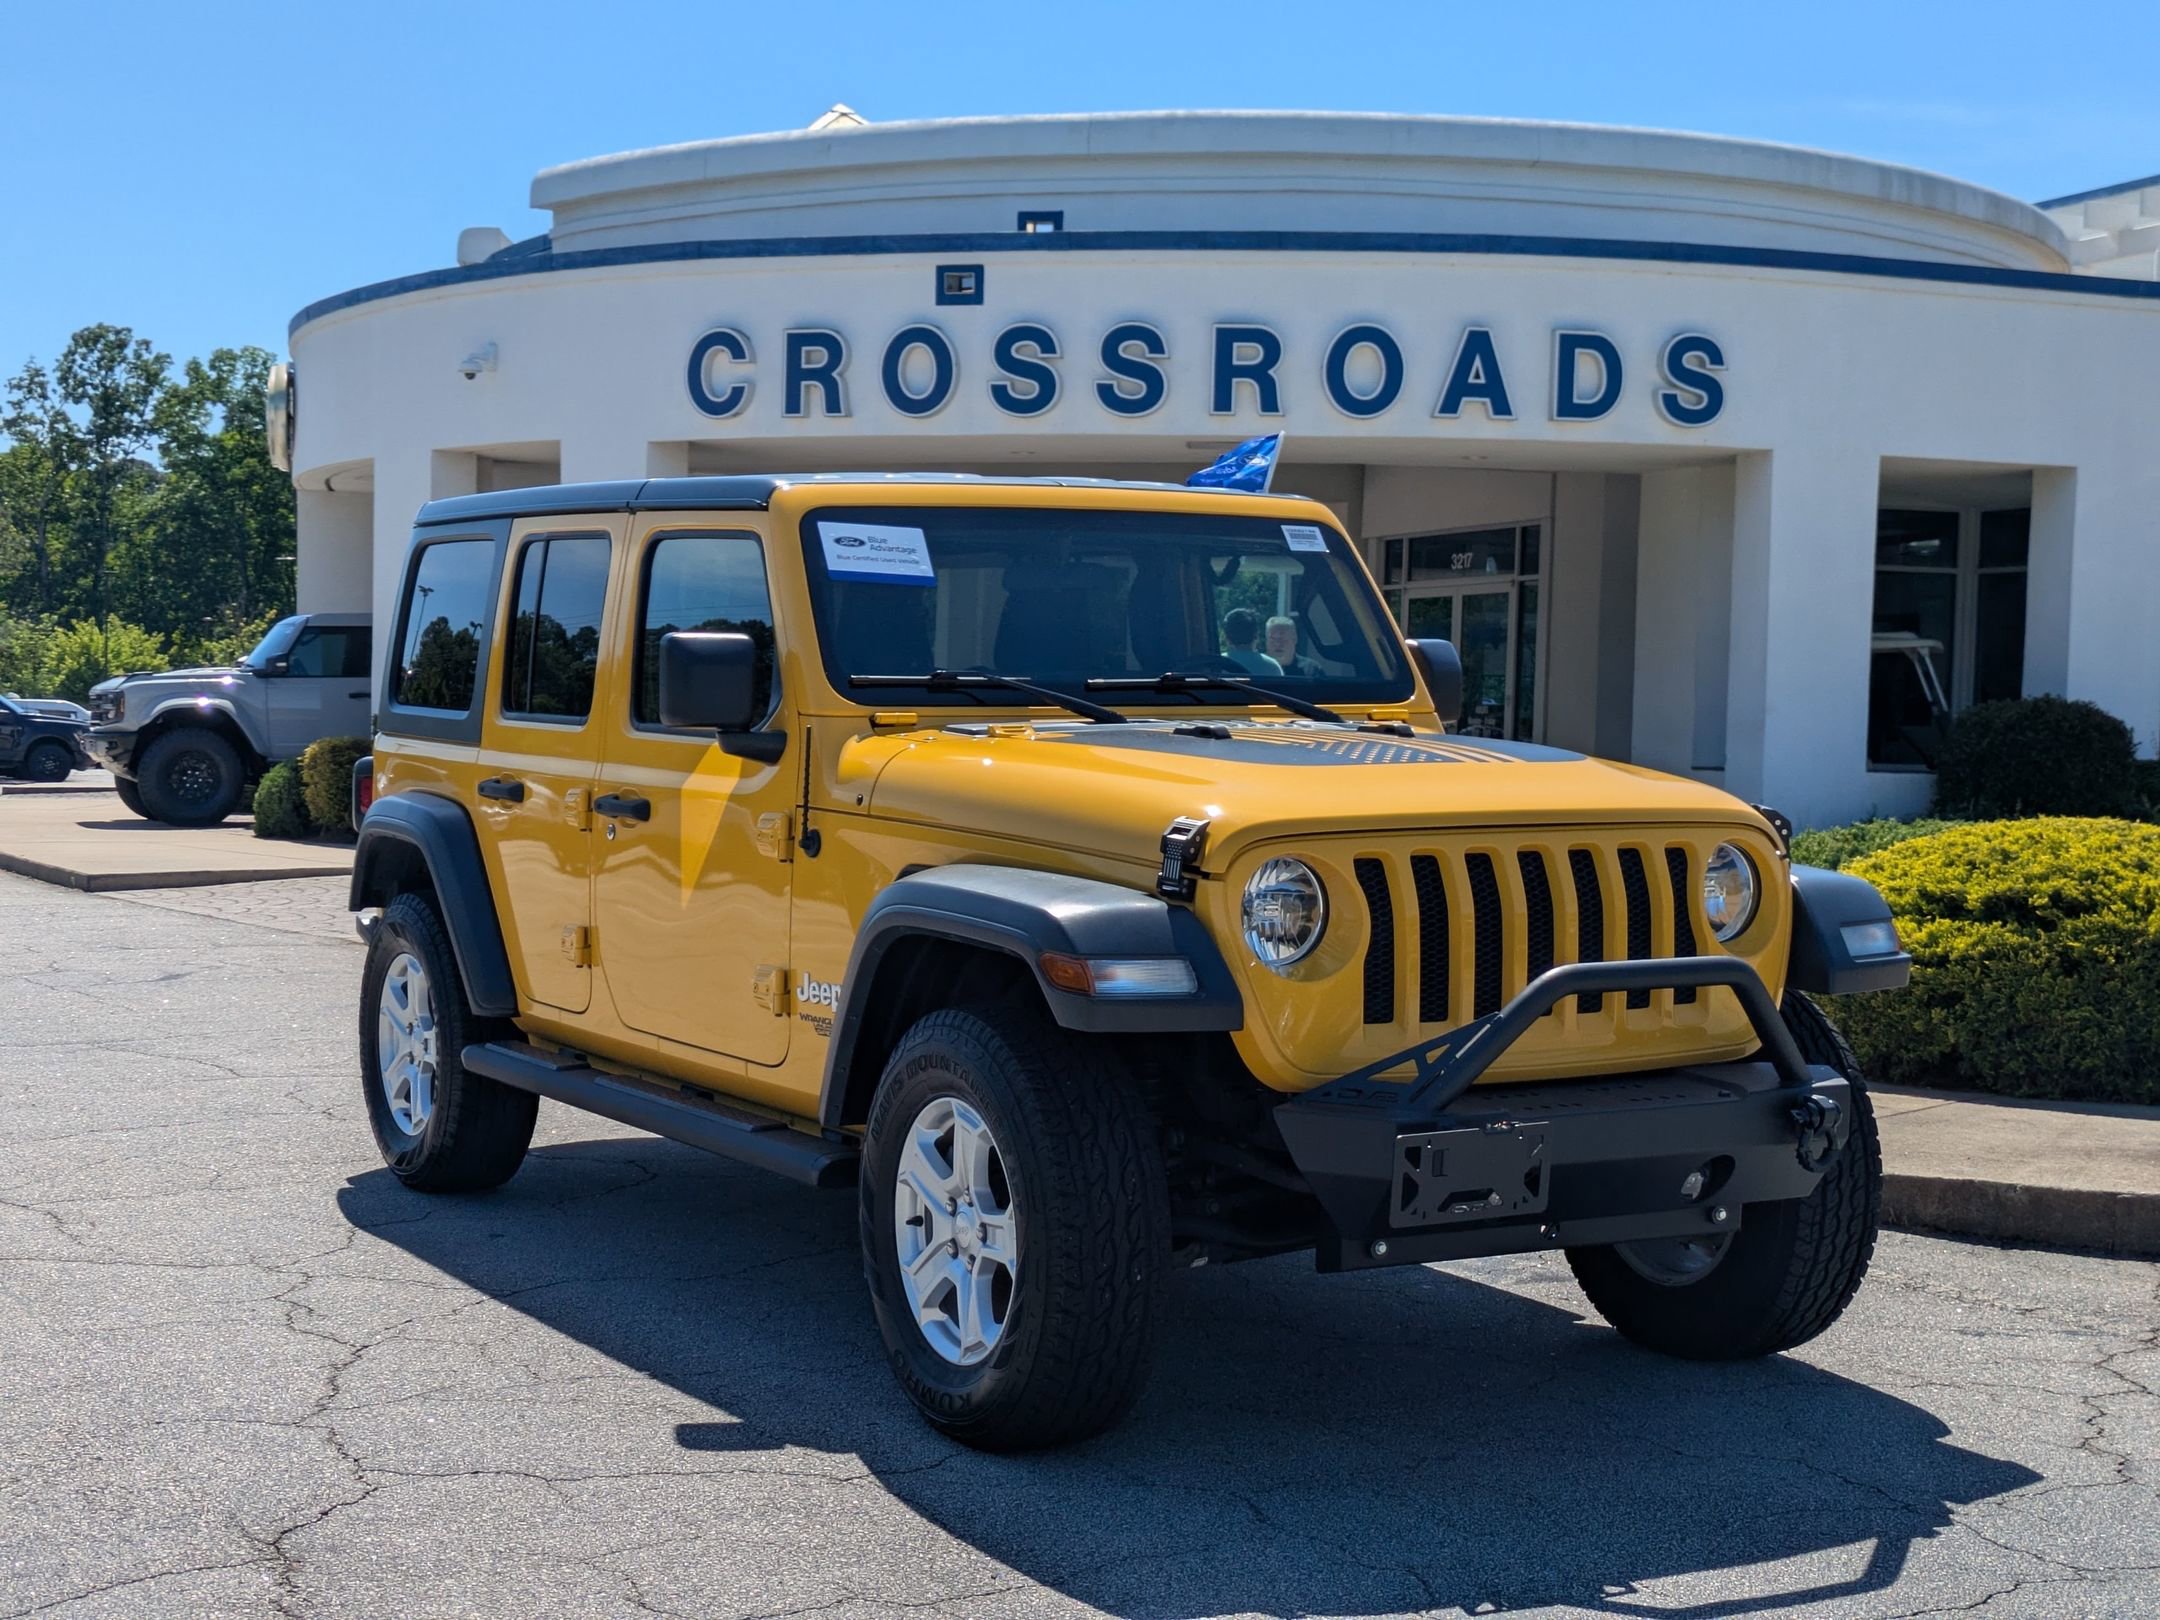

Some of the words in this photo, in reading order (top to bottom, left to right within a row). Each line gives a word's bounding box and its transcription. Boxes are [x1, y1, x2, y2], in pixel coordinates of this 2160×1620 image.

[686, 323, 1727, 427] CROSSROADS
[867, 536, 888, 545] Blue
[870, 544, 918, 555] Advantage
[1451, 552, 1473, 571] 3217
[797, 972, 842, 1013] Jeep
